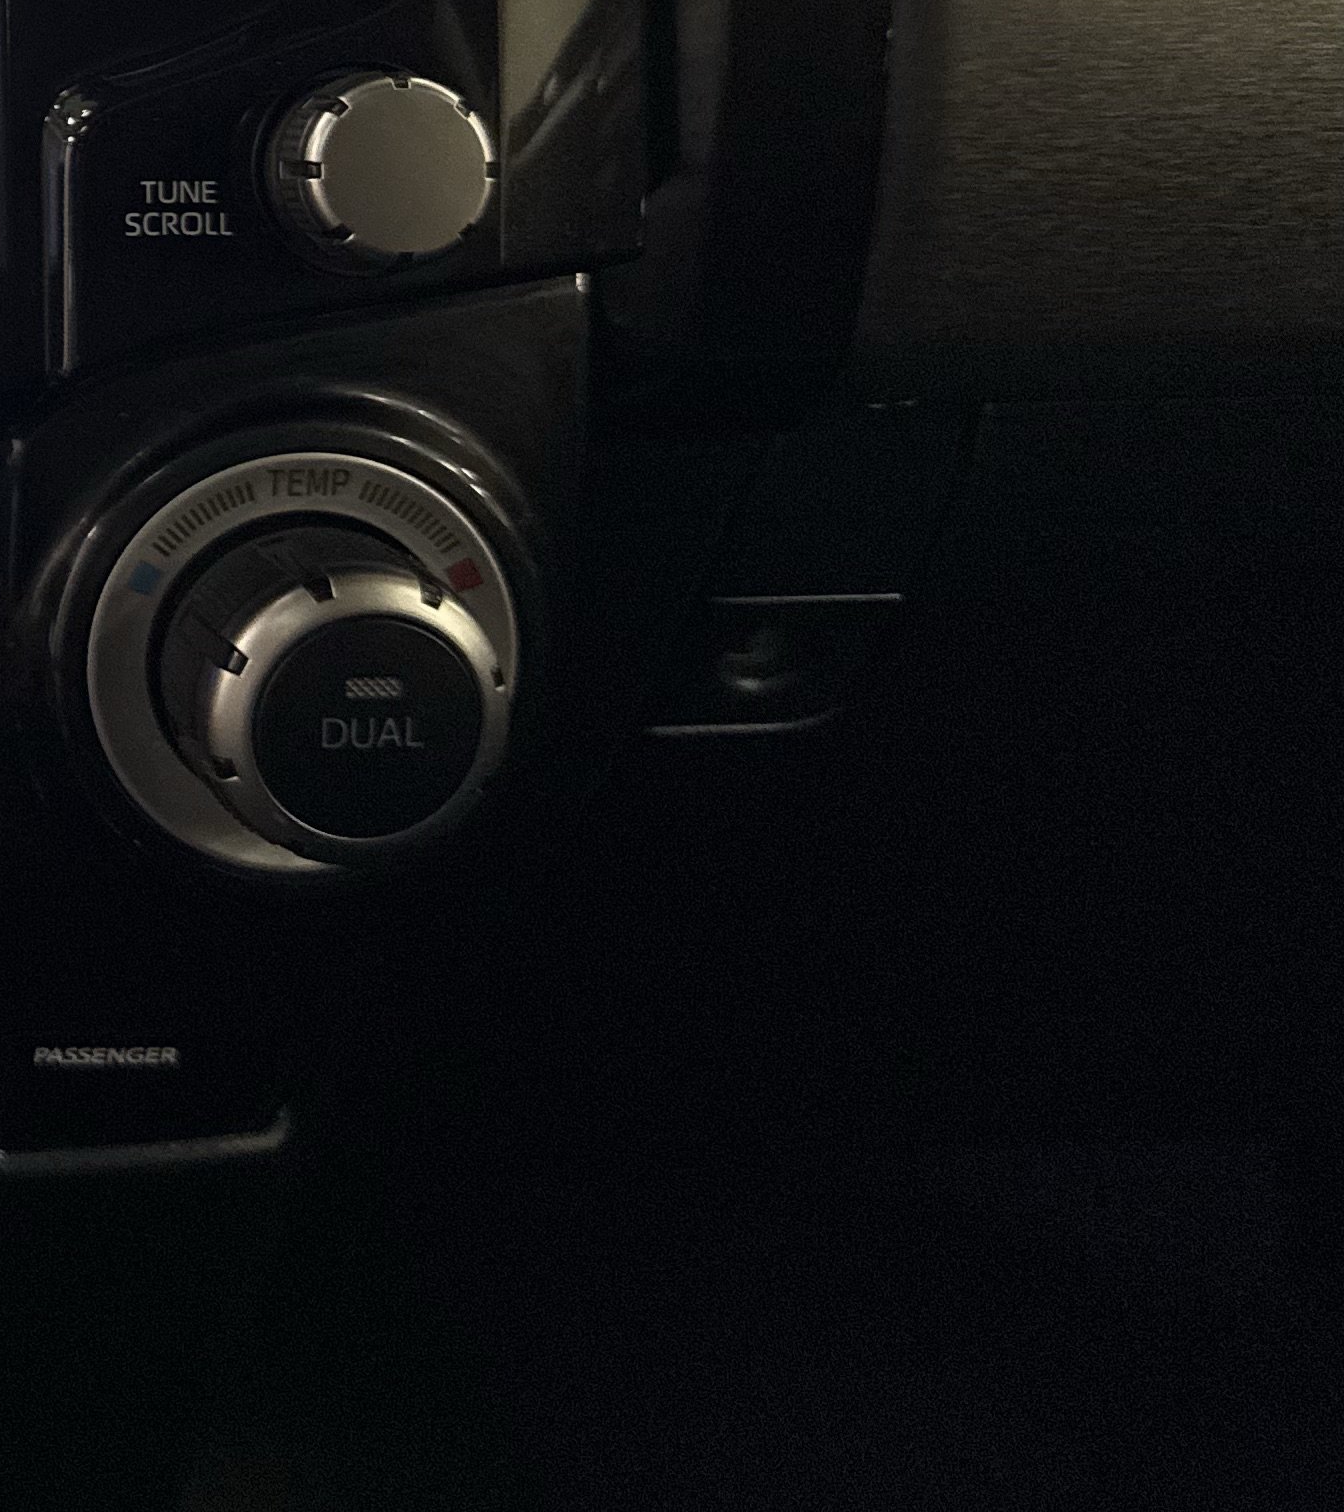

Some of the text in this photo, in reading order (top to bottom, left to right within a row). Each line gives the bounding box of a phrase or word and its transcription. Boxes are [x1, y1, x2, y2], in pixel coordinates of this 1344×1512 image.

[140, 180, 218, 204] TUNE
[125, 211, 233, 237] SCROLL
[267, 467, 350, 497] TEMP
[321, 717, 426, 749] DUAL
[34, 1046, 179, 1065] PASSENGER
